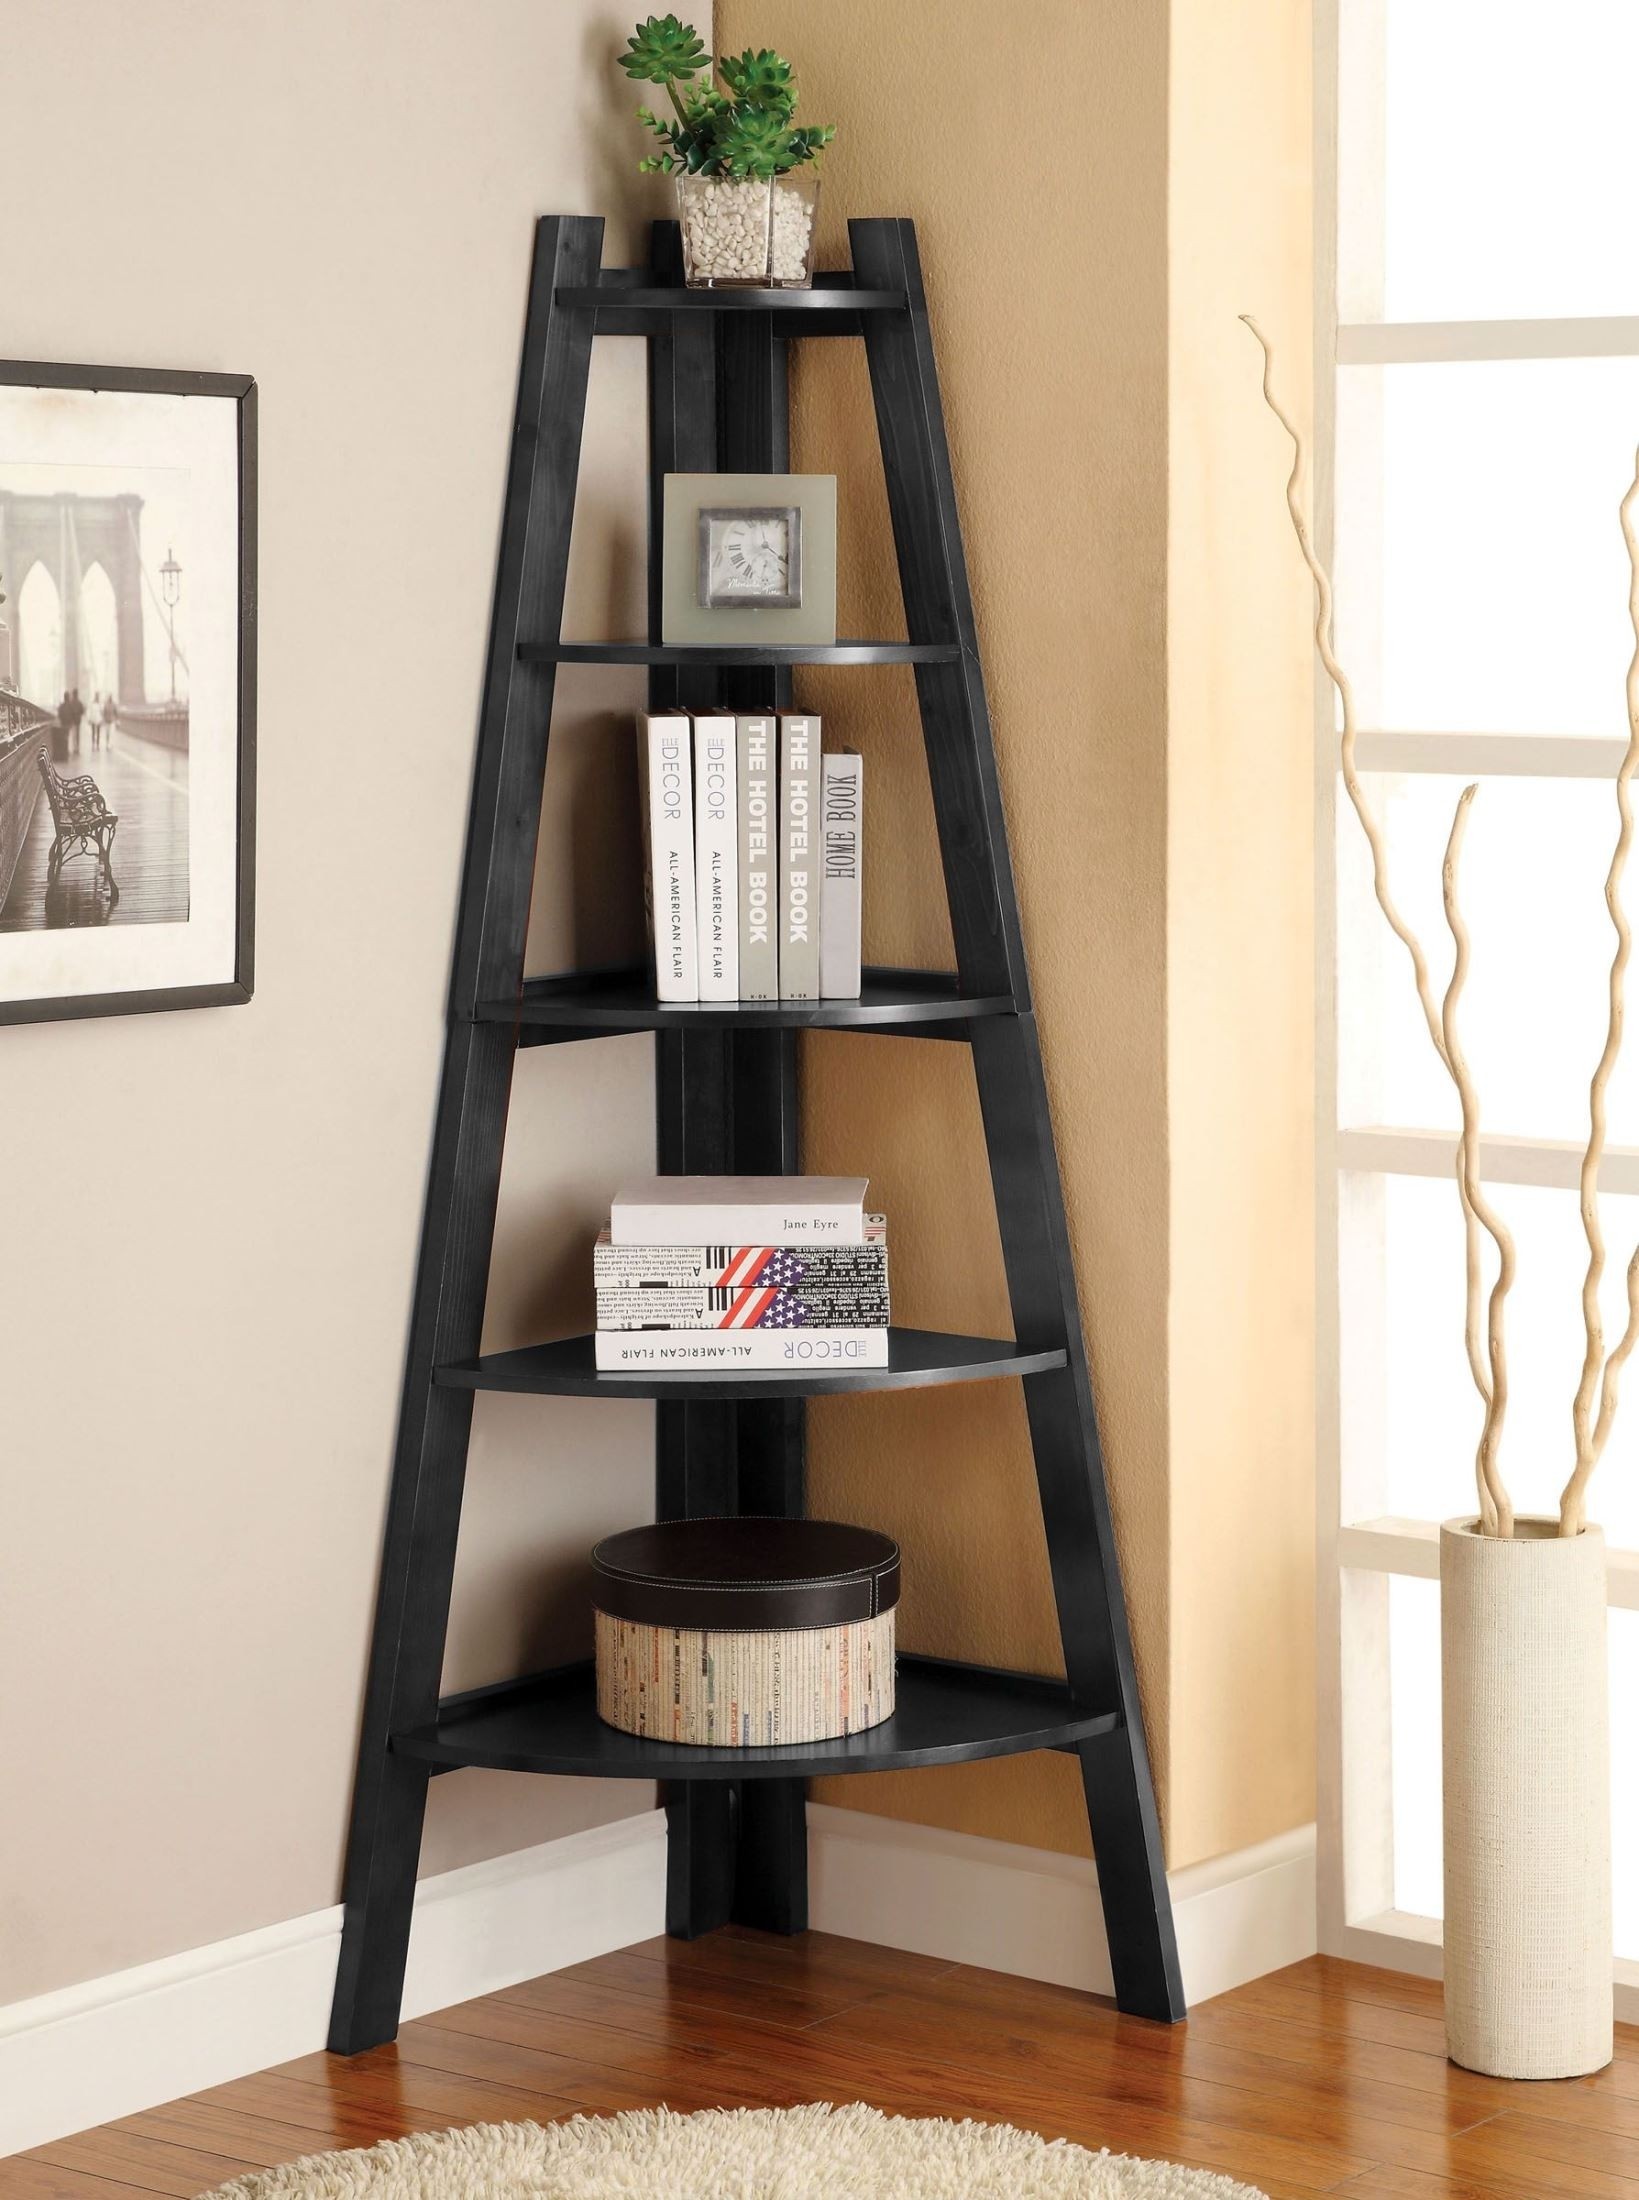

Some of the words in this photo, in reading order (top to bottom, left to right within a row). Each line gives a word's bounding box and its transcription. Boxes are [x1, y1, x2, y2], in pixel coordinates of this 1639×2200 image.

[749, 721, 767, 771] THE
[791, 720, 808, 770] THE
[662, 747, 680, 819] DECOR
[707, 747, 725, 819] DECOR
[827, 773, 857, 821] BOOK
[749, 780, 767, 862] HOTEL
[791, 780, 808, 862] HOTEL
[826, 830, 855, 879] HOME
[669, 851, 681, 940] ALL-AMERICAN
[712, 851, 722, 940] ALL-AMERICAN
[749, 872, 767, 943] BOOK
[790, 871, 808, 943] BOOK
[672, 947, 682, 978] FLAIR
[713, 947, 722, 978] FLAIR
[784, 1219, 807, 1230] Jane
[814, 1220, 838, 1231] Eyre
[693, 1267, 701, 1276] A
[695, 1308, 703, 1318] A
[622, 1349, 654, 1359] FLAIR
[660, 1347, 752, 1357] ALL-AMERICAN
[784, 1340, 857, 1359] DECOR
